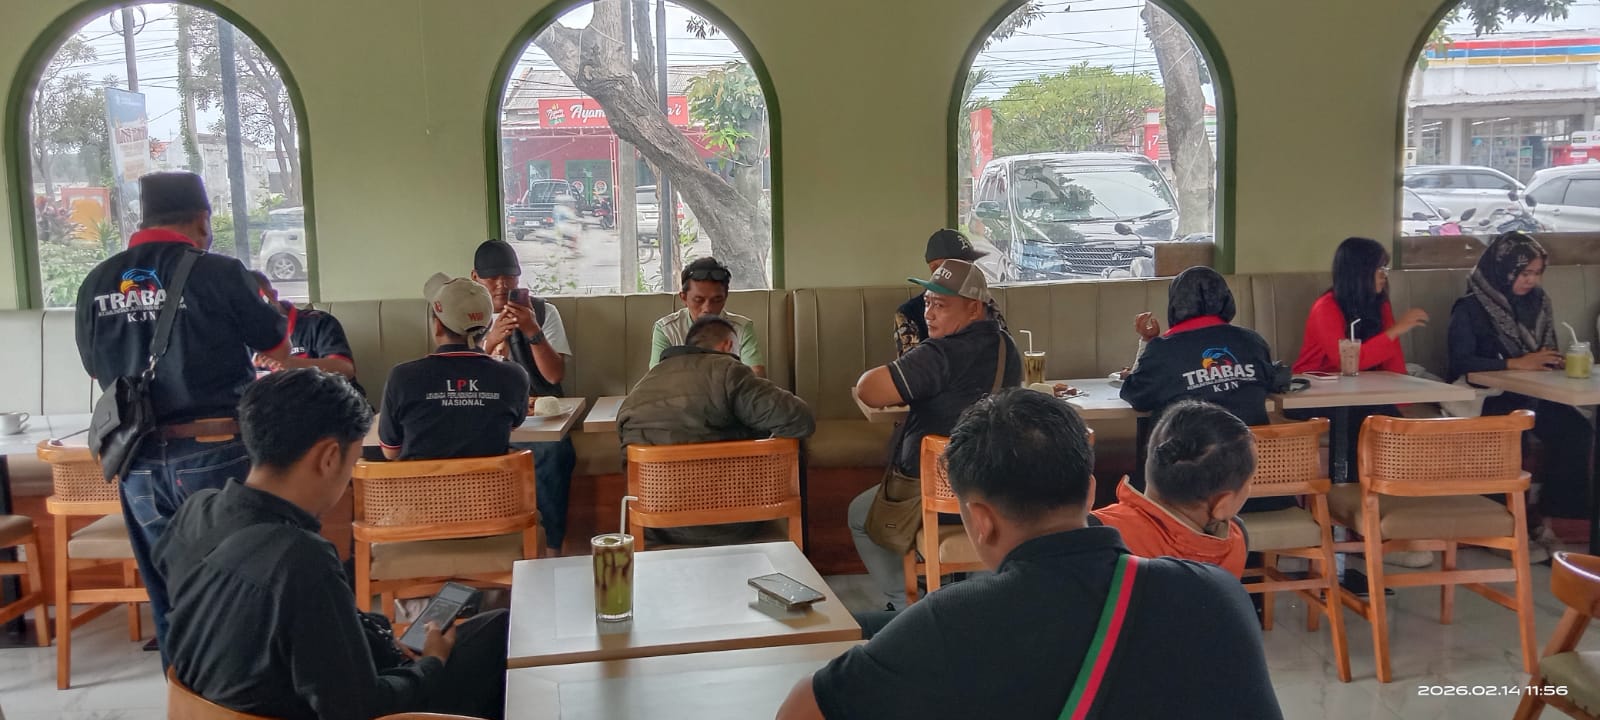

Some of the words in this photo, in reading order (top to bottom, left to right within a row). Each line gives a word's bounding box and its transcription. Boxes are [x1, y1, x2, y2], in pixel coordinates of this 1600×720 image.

[569, 104, 607, 123] Ayam
[1182, 364, 1256, 386] TRABAS
[441, 399, 485, 407] NASIONAL
